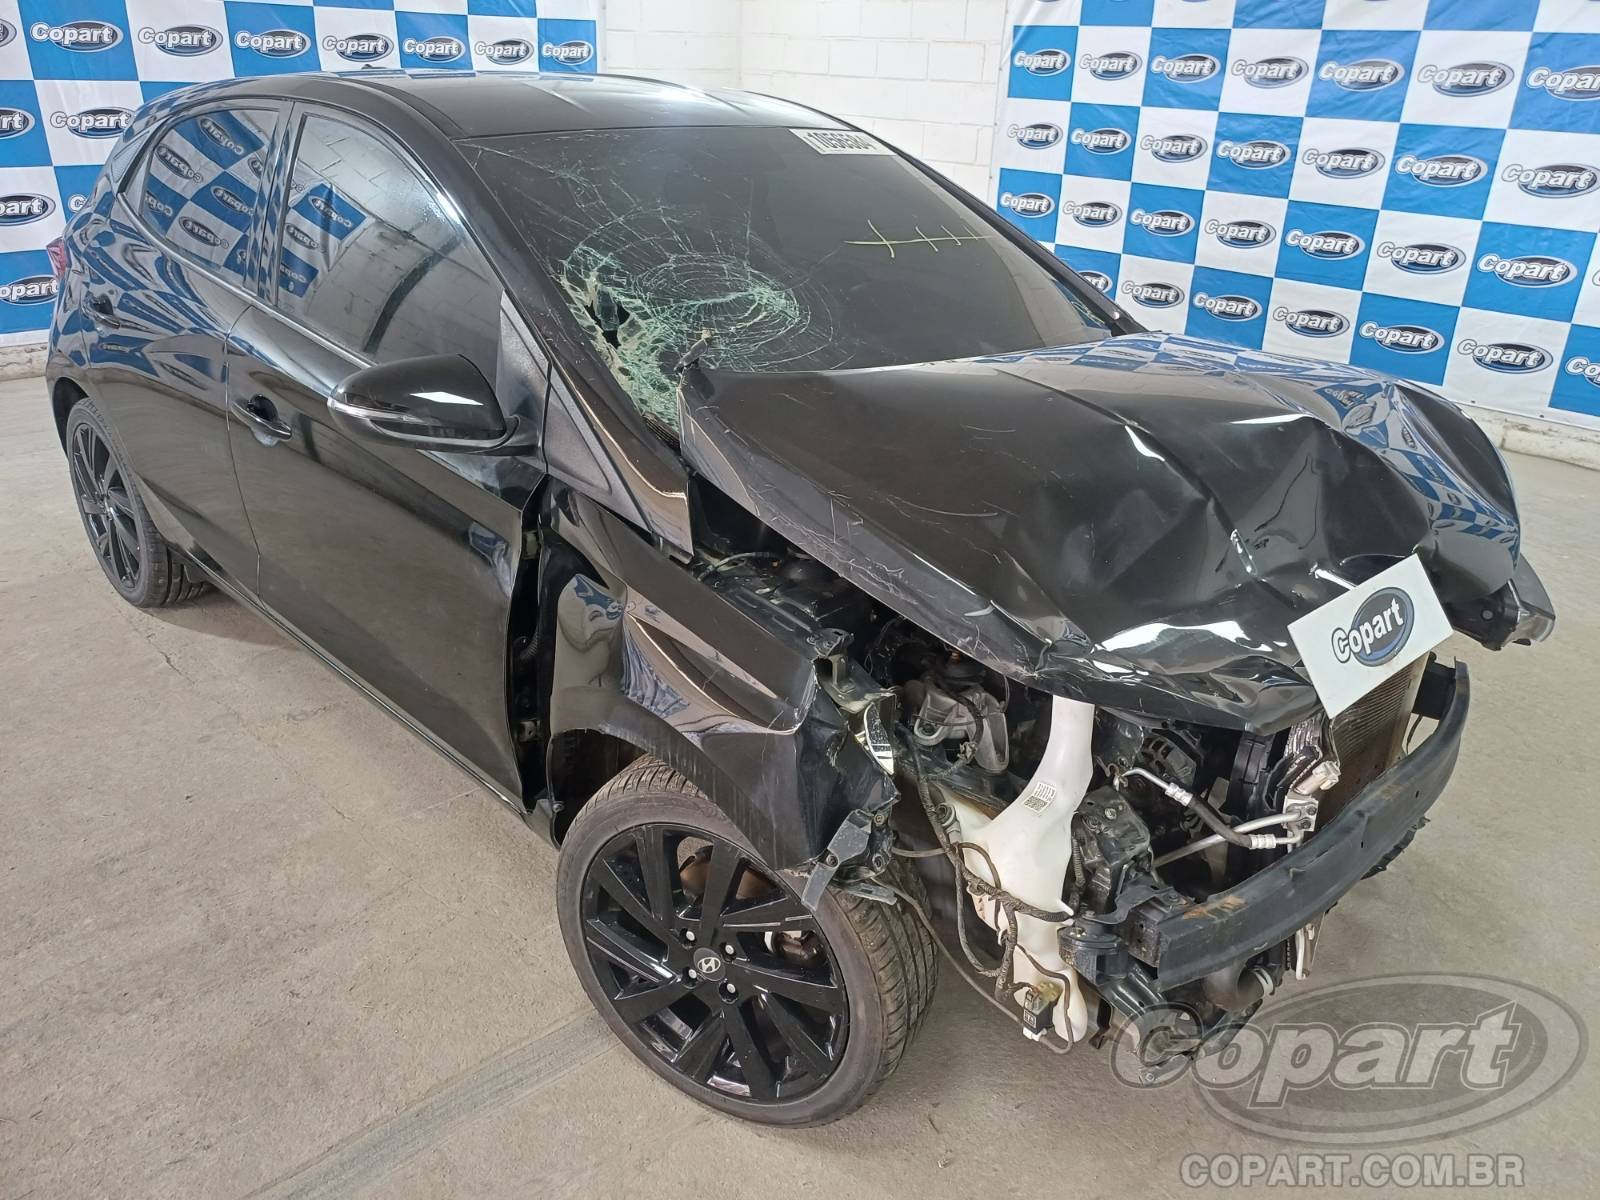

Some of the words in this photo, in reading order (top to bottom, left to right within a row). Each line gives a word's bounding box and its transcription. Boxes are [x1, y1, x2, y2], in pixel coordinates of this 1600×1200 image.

[30, 22, 113, 46] Copart
[138, 27, 212, 48] Copart
[235, 31, 303, 52] Copart
[323, 36, 387, 54] Copart
[403, 38, 459, 58] Copart
[474, 41, 527, 59] Copart
[542, 43, 589, 60] Copart
[1014, 49, 1065, 71] Copart
[1080, 51, 1136, 74] Copart
[1151, 54, 1215, 78] Copart
[1232, 60, 1300, 83] Copart
[1319, 61, 1397, 86] Copart
[1417, 65, 1503, 88] Copart
[1527, 67, 1600, 94] Copar
[50, 111, 130, 132] Copart
[1008, 124, 1058, 145] Copart
[1071, 127, 1126, 150] Copart
[1141, 136, 1201, 159] Copart
[1216, 141, 1284, 165] Copart
[1302, 148, 1378, 173] Copart
[1396, 155, 1480, 182] Copart
[1502, 164, 1595, 193] Copart
[1000, 192, 1049, 214] Copart
[1063, 201, 1116, 223] Copart
[1131, 210, 1189, 233] Copart
[1205, 220, 1270, 245] Copart
[1286, 230, 1358, 255] Copart
[1377, 242, 1457, 270] Copart
[1478, 254, 1568, 283] Copart
[0, 279, 58, 303] opart
[1121, 281, 1180, 304] Copart
[1193, 292, 1259, 317] Copart
[1273, 307, 1342, 333] Copart
[1360, 321, 1437, 349] Copart
[1457, 338, 1545, 369] Copart
[1331, 597, 1404, 663] Copart
